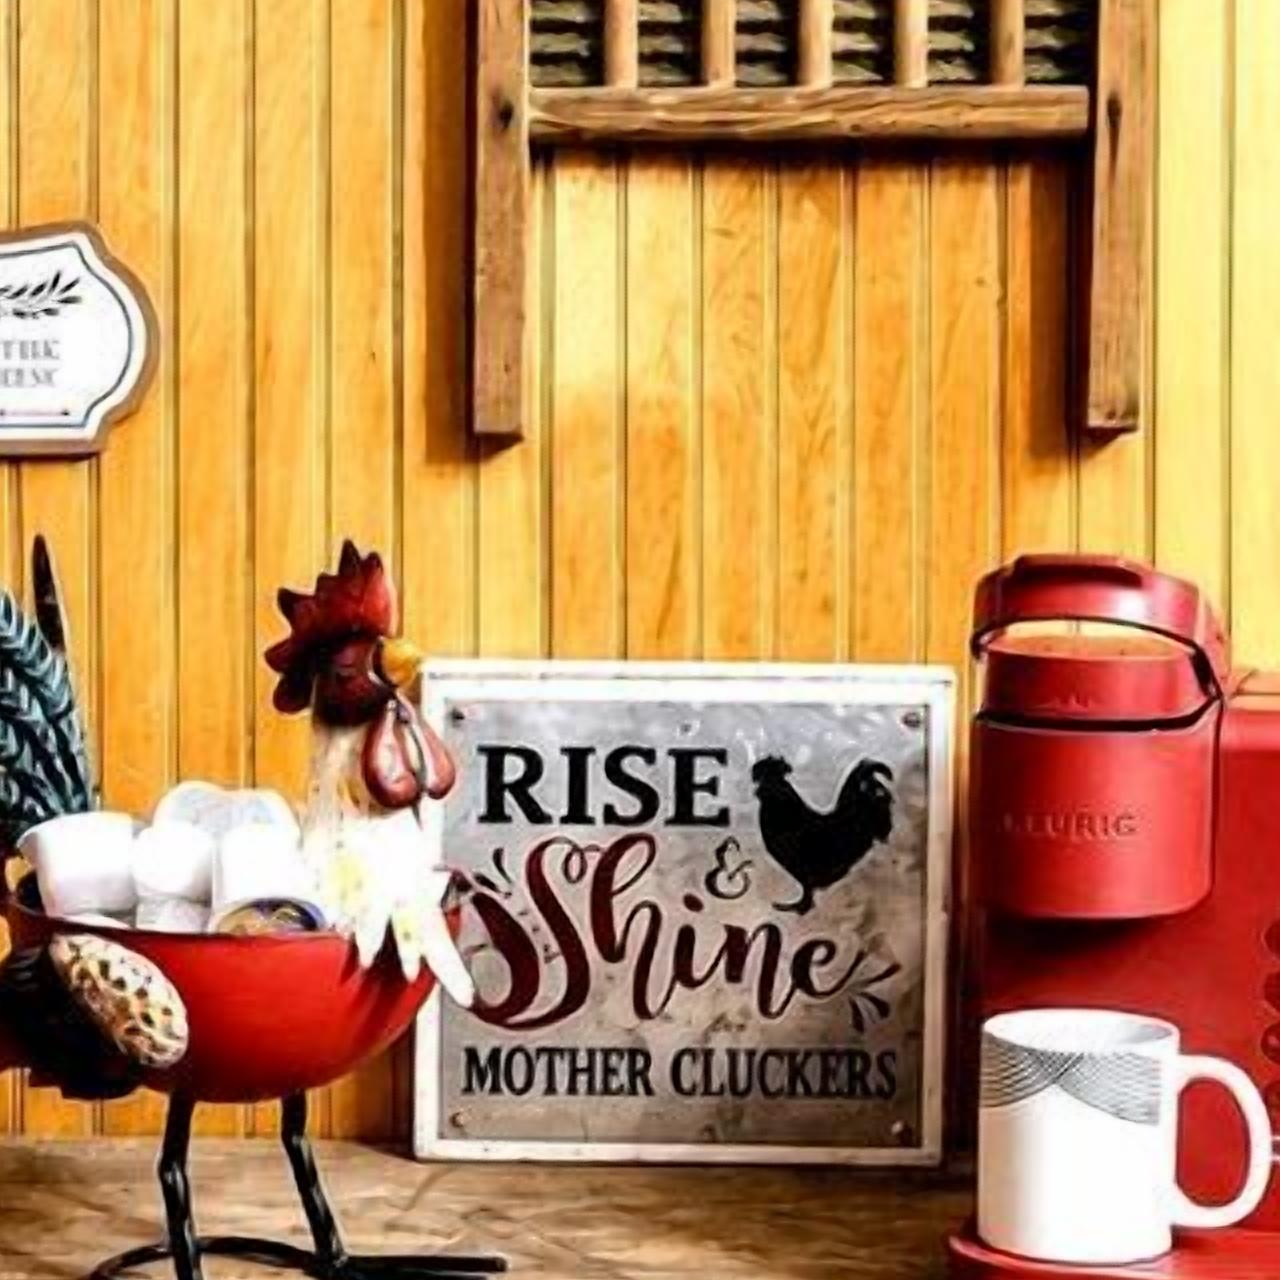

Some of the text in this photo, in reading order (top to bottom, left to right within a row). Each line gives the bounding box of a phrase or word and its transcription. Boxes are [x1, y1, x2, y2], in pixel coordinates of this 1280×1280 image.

[475, 744, 729, 827] RISE
[1000, 809, 1141, 842] EURIG
[705, 835, 754, 900] &
[470, 831, 866, 1032] Shine
[461, 1045, 898, 1099] MOTHER CLUCKERS
